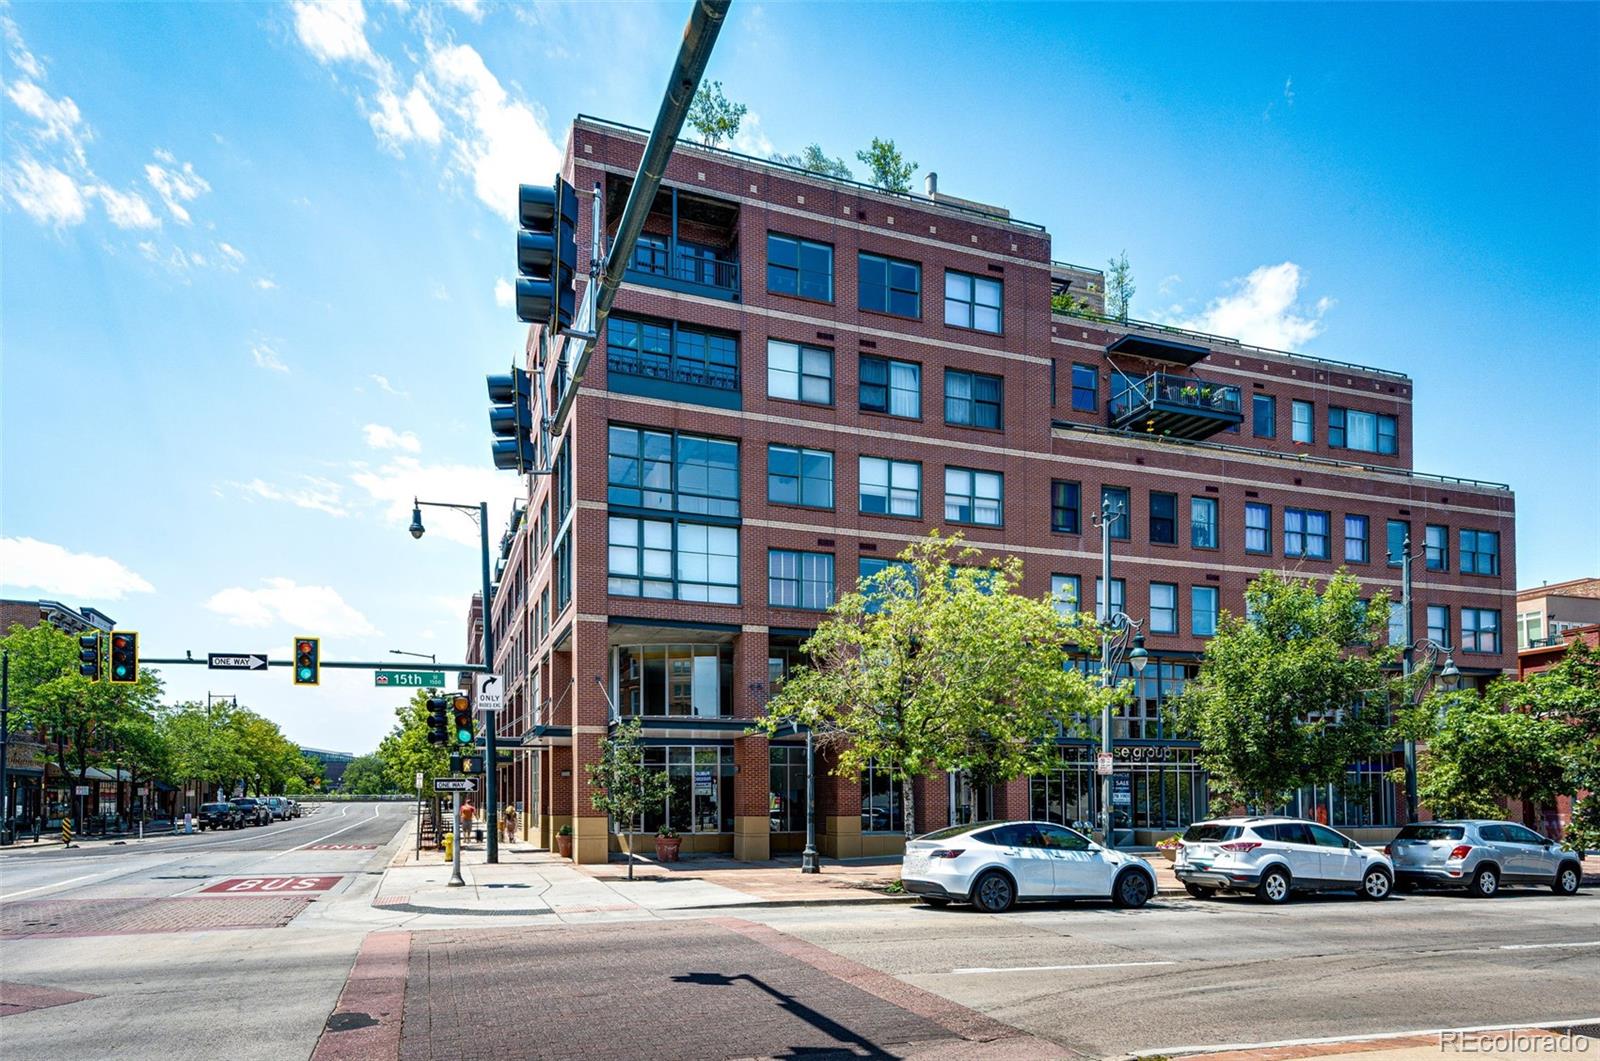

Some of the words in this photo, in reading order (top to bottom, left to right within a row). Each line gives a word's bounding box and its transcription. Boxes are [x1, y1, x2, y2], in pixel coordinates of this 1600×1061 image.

[214, 657, 231, 665] ONE
[394, 674, 422, 685] 15th
[1133, 746, 1172, 761] group
[226, 878, 321, 891] BUS
